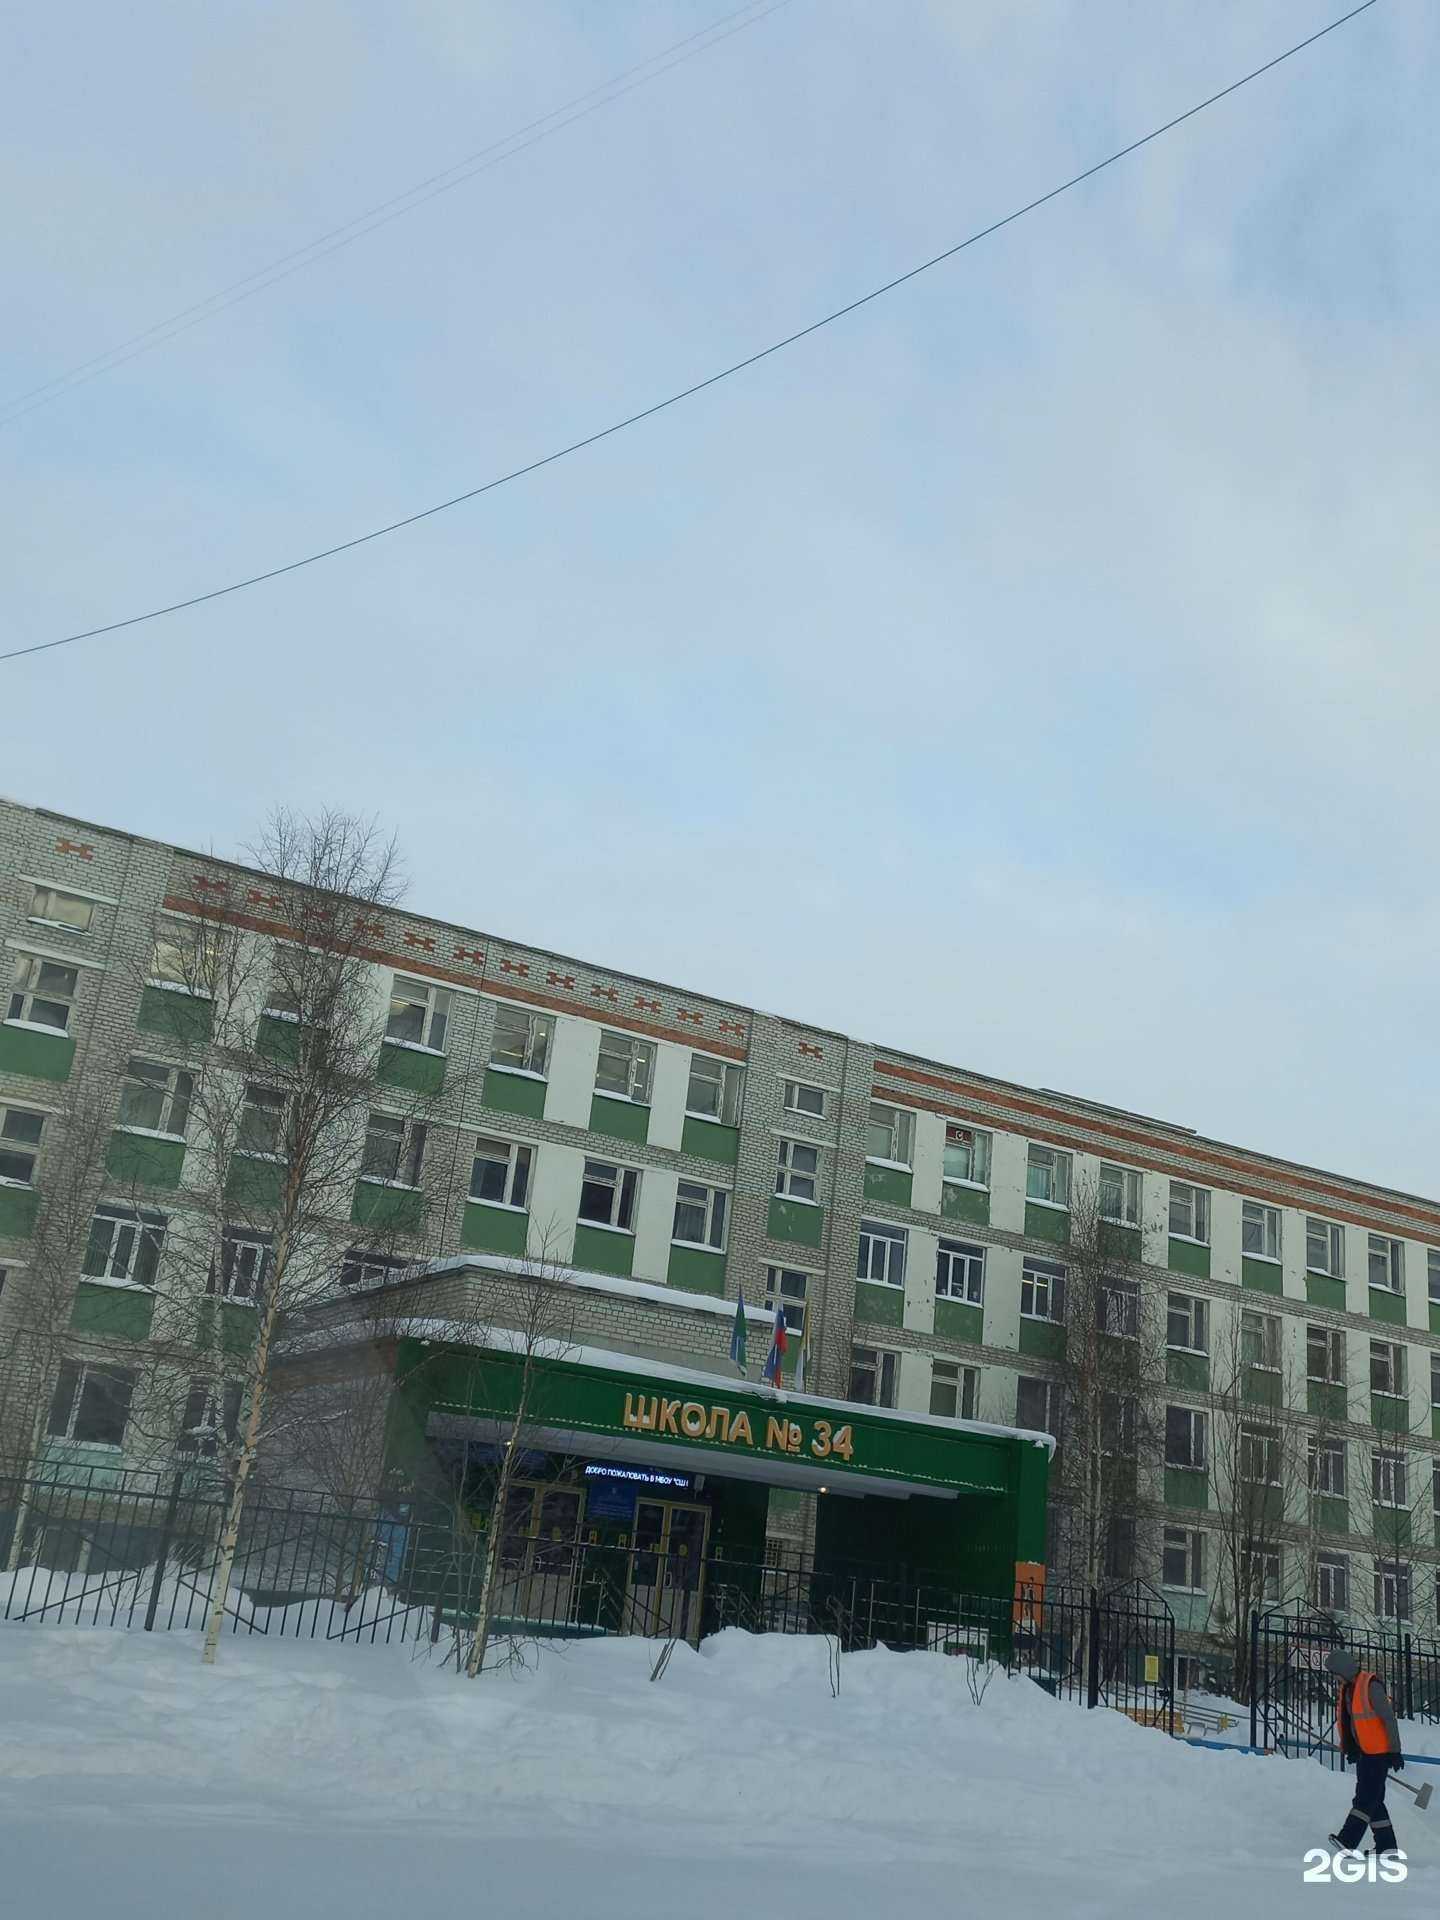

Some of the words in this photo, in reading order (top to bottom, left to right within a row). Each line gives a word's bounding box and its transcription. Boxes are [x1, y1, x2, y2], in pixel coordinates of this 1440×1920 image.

[623, 1392, 754, 1446] ШКОЛА
[766, 1416, 802, 1453] №
[811, 1420, 854, 1461] 34
[585, 1466, 607, 1476] ДОБРО
[607, 1469, 649, 1482] ПОЖАЛОВАТЬ
[650, 1474, 655, 1482] В
